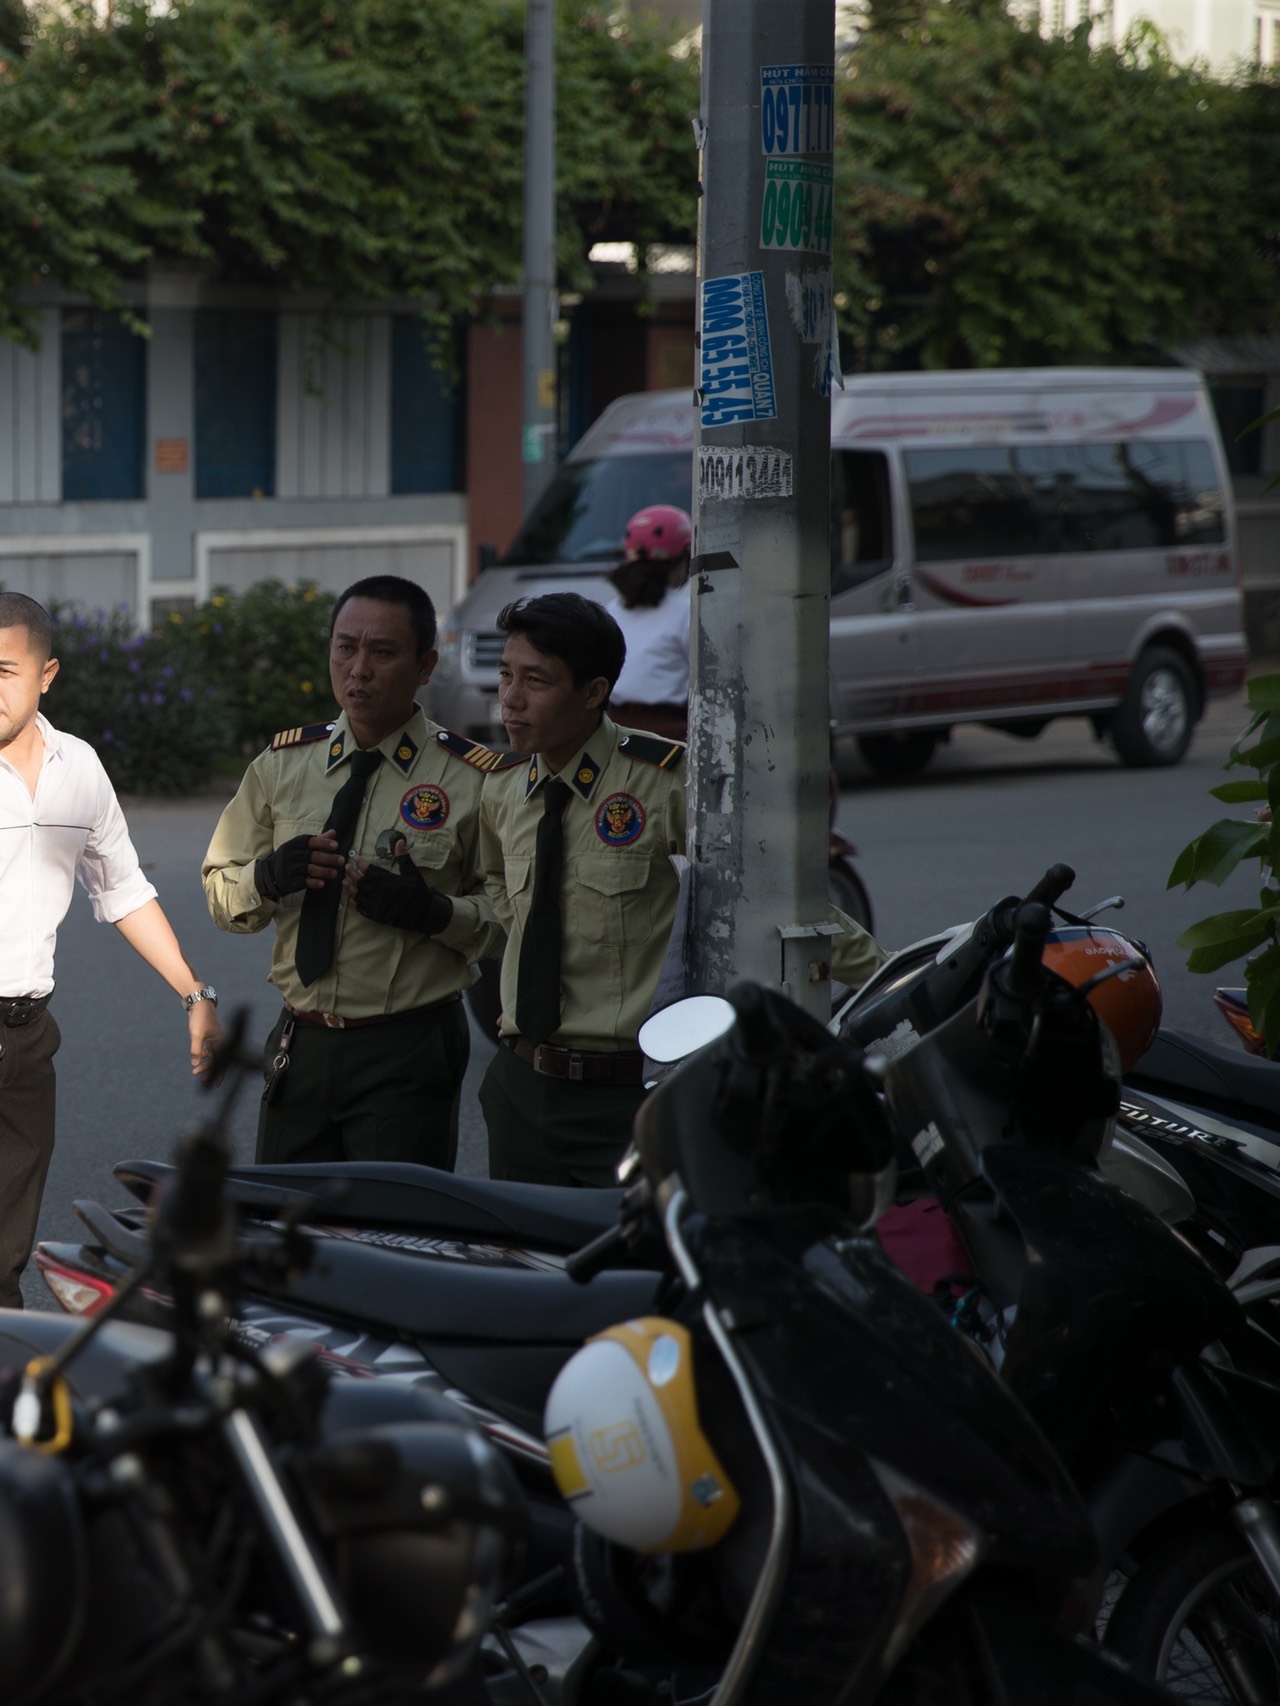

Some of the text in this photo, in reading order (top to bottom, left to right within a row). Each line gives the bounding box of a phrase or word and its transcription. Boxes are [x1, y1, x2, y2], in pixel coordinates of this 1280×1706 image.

[751, 274, 762, 295] CÔNG
[754, 296, 763, 307] TY
[755, 319, 765, 336] SINH
[758, 336, 768, 357] CÔNG
[752, 372, 773, 417] QUẬN 7
